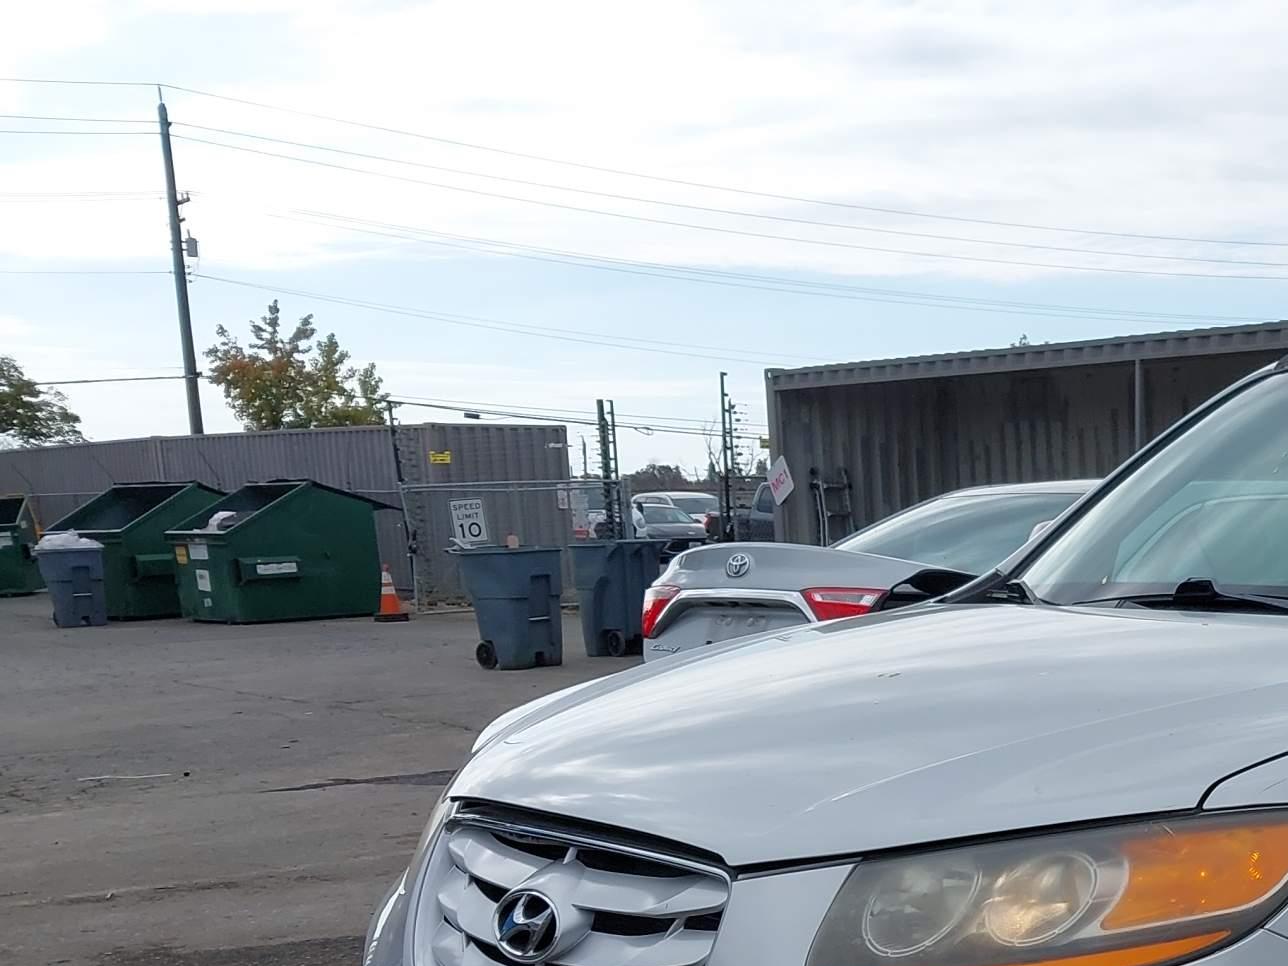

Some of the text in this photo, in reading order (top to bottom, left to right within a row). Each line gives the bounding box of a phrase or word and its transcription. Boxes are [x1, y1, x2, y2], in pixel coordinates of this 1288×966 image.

[452, 502, 481, 512] SPEED
[457, 511, 479, 520] LIMIT
[458, 522, 482, 539] 10
